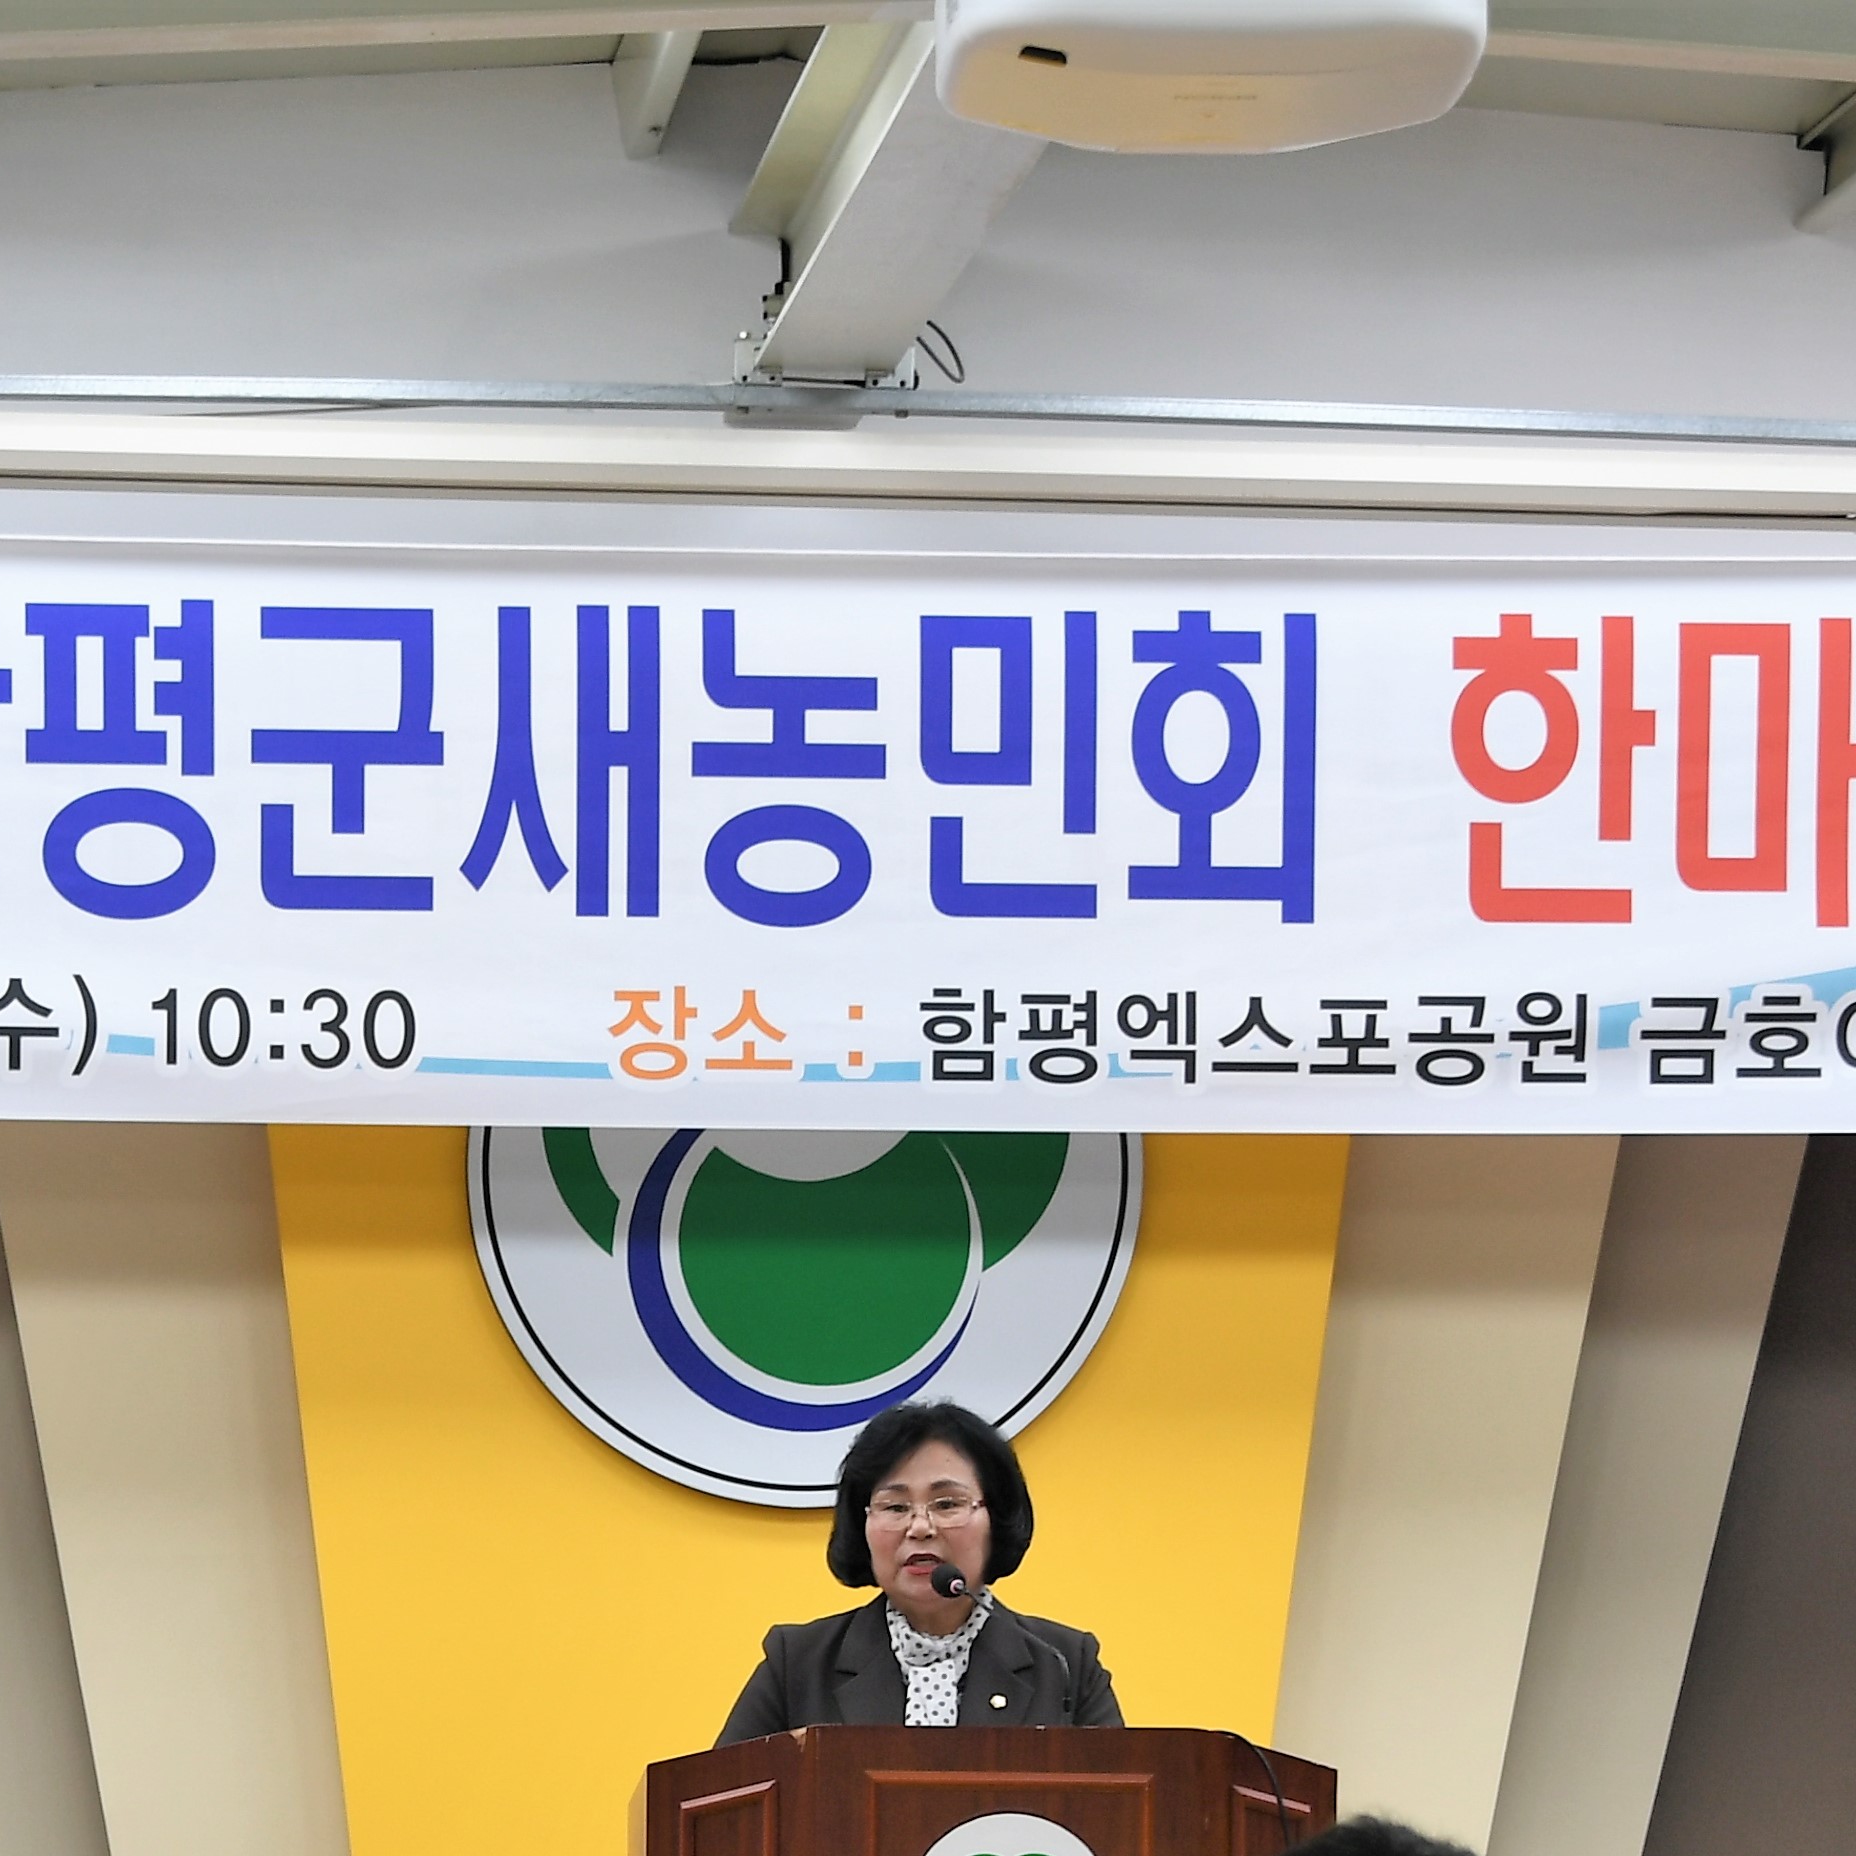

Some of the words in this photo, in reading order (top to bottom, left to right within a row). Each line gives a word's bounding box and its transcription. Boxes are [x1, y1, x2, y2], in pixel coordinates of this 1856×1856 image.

[150, 986, 417, 1071] 10:30
[609, 984, 795, 1081] 장소
[918, 986, 1590, 1087] 함평엑스포공원
